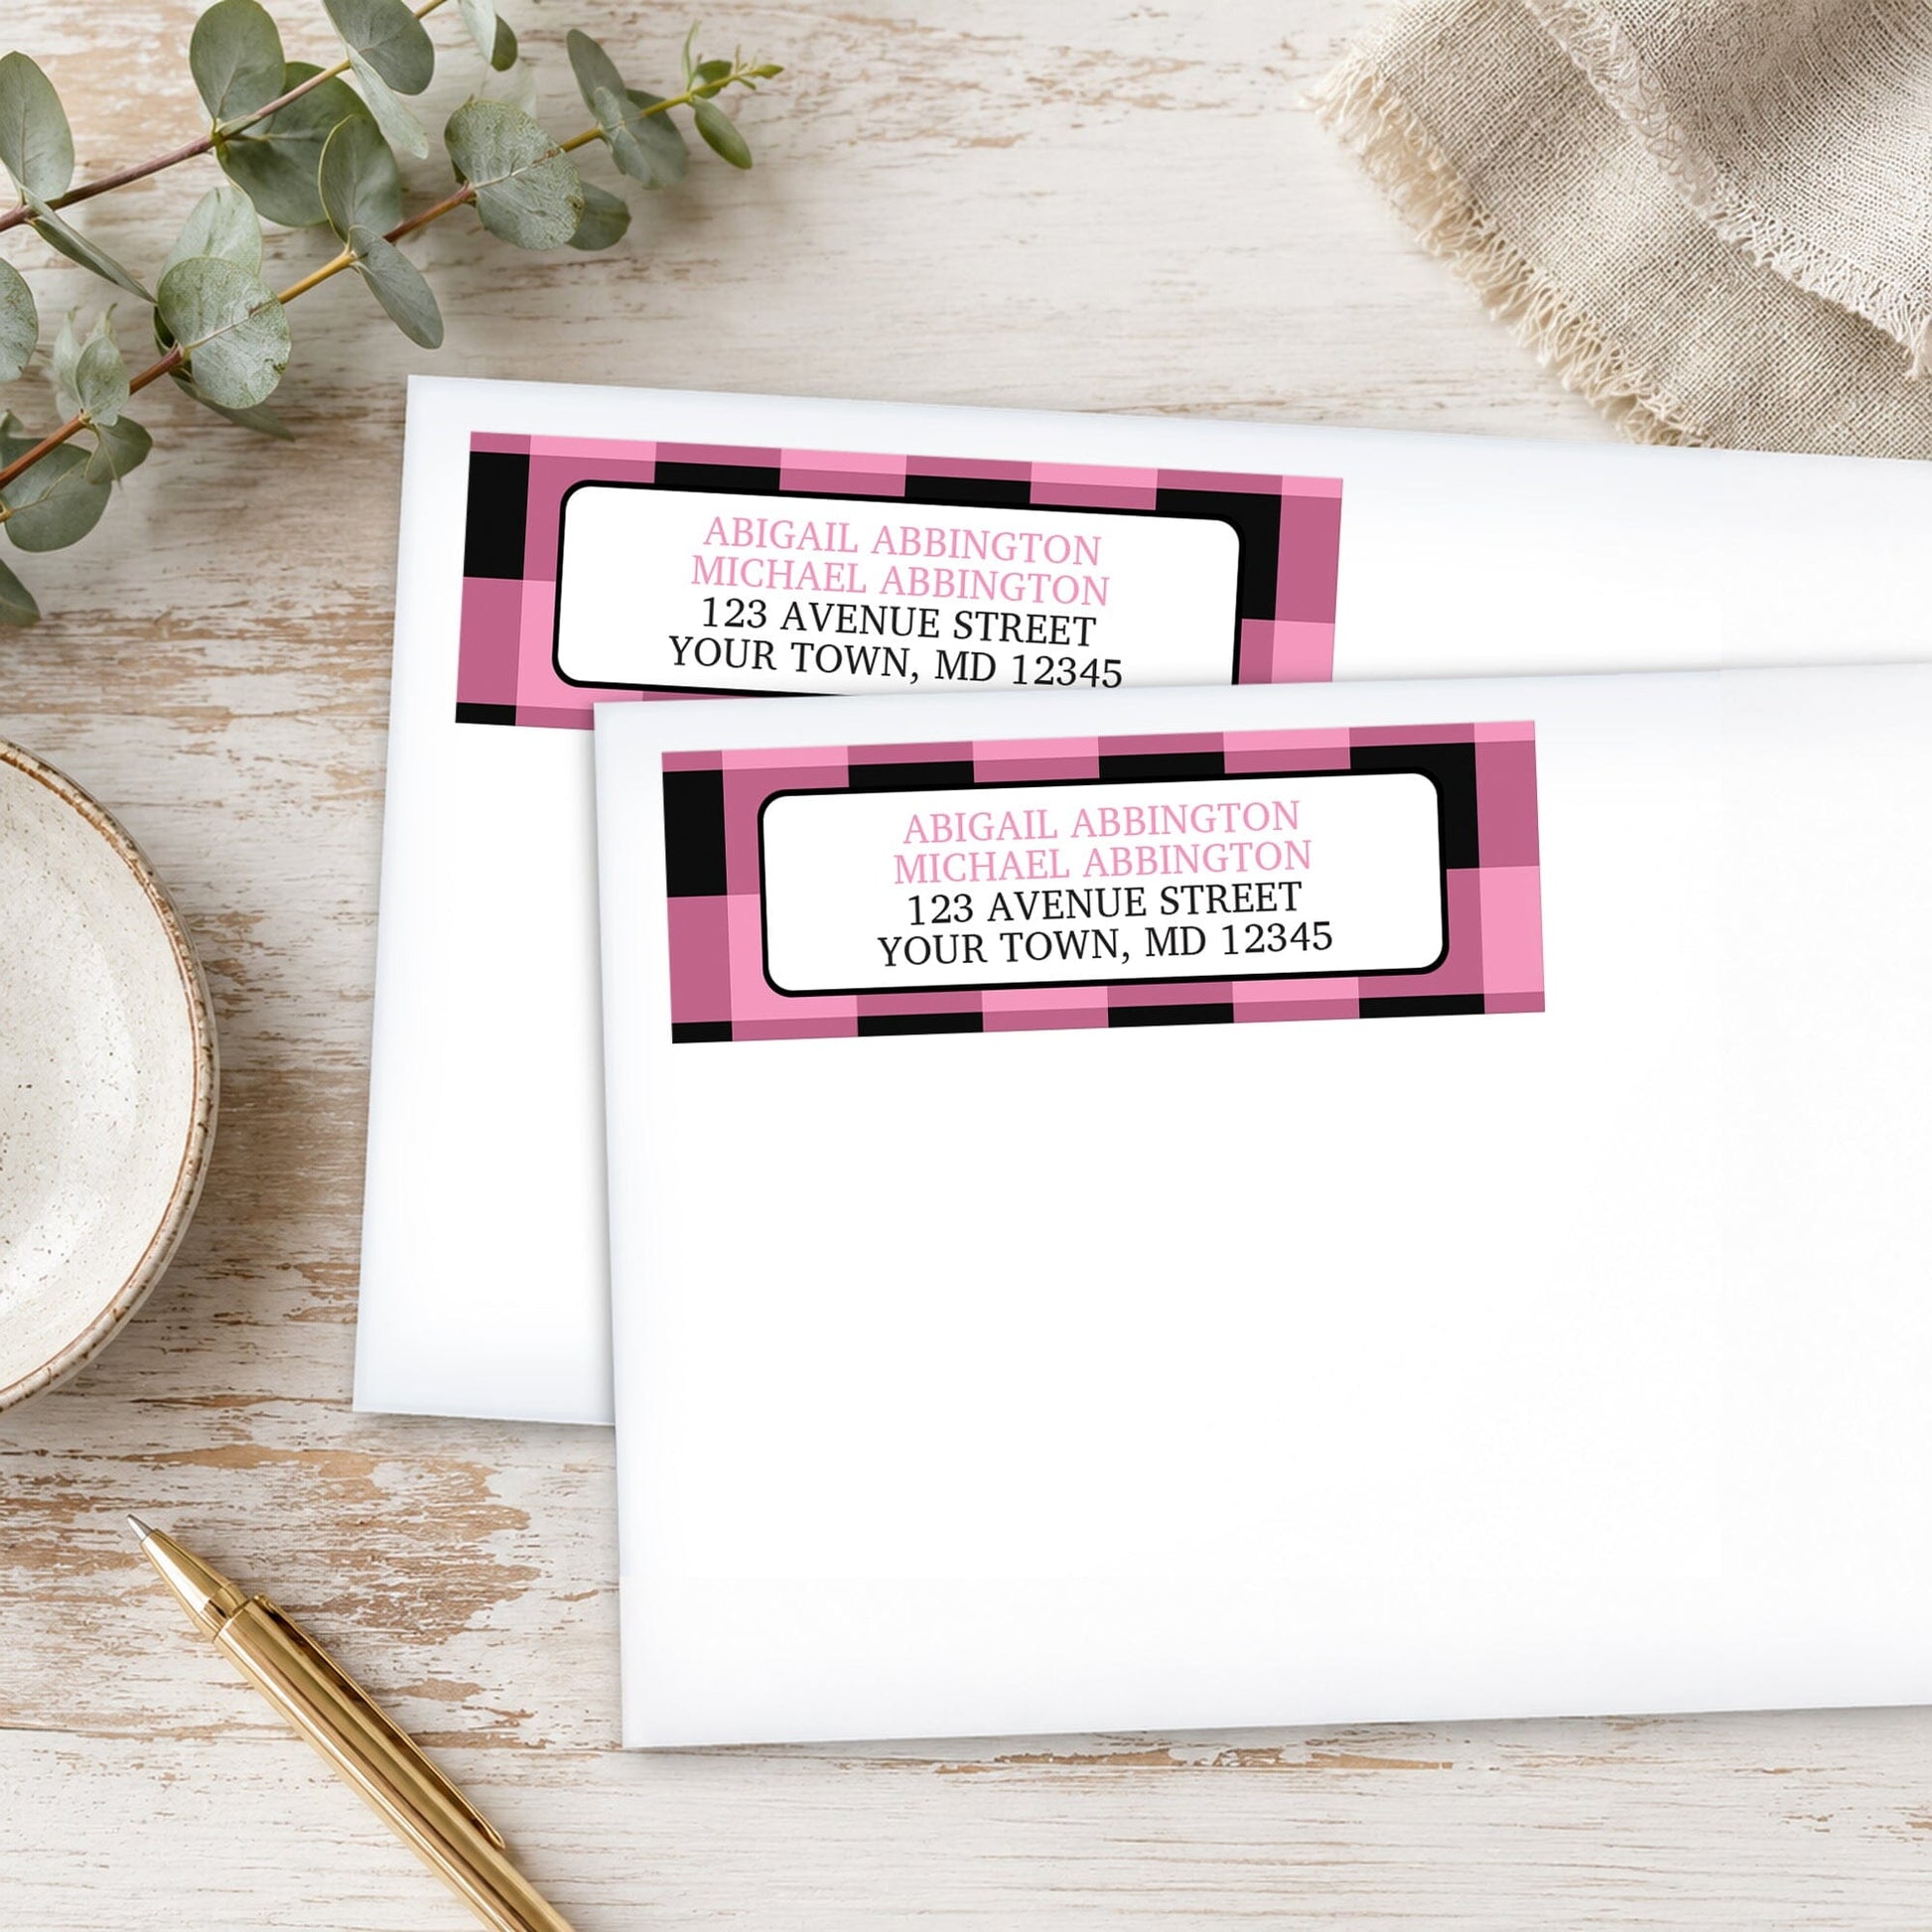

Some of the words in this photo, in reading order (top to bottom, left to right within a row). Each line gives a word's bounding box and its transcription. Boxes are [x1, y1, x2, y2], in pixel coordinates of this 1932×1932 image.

[703, 515, 859, 553] ABIGAIL
[871, 525, 1102, 566] ABBINGTON
[691, 554, 867, 594] MICHAEL
[879, 565, 1110, 607] ABBINGTON
[702, 596, 767, 628] 123
[780, 601, 940, 638] AVENUE
[953, 610, 1096, 647] STREET
[668, 635, 776, 670] YOUR
[791, 641, 919, 684] TOWN,
[934, 649, 996, 682] MD
[1013, 654, 1123, 688] 12345
[903, 809, 1057, 844] ABIGAIL
[1071, 800, 1301, 839] ABBINGTON
[894, 849, 1070, 885] MICHAEL
[1083, 840, 1311, 878] ABBINGTON
[909, 894, 973, 925] 123
[988, 887, 1147, 922] AVENUE
[1160, 881, 1303, 915] STREET
[878, 933, 988, 967] YOUR
[1000, 928, 1130, 964] TOWN,
[1146, 925, 1205, 957] MD
[1222, 920, 1333, 955] 12345
